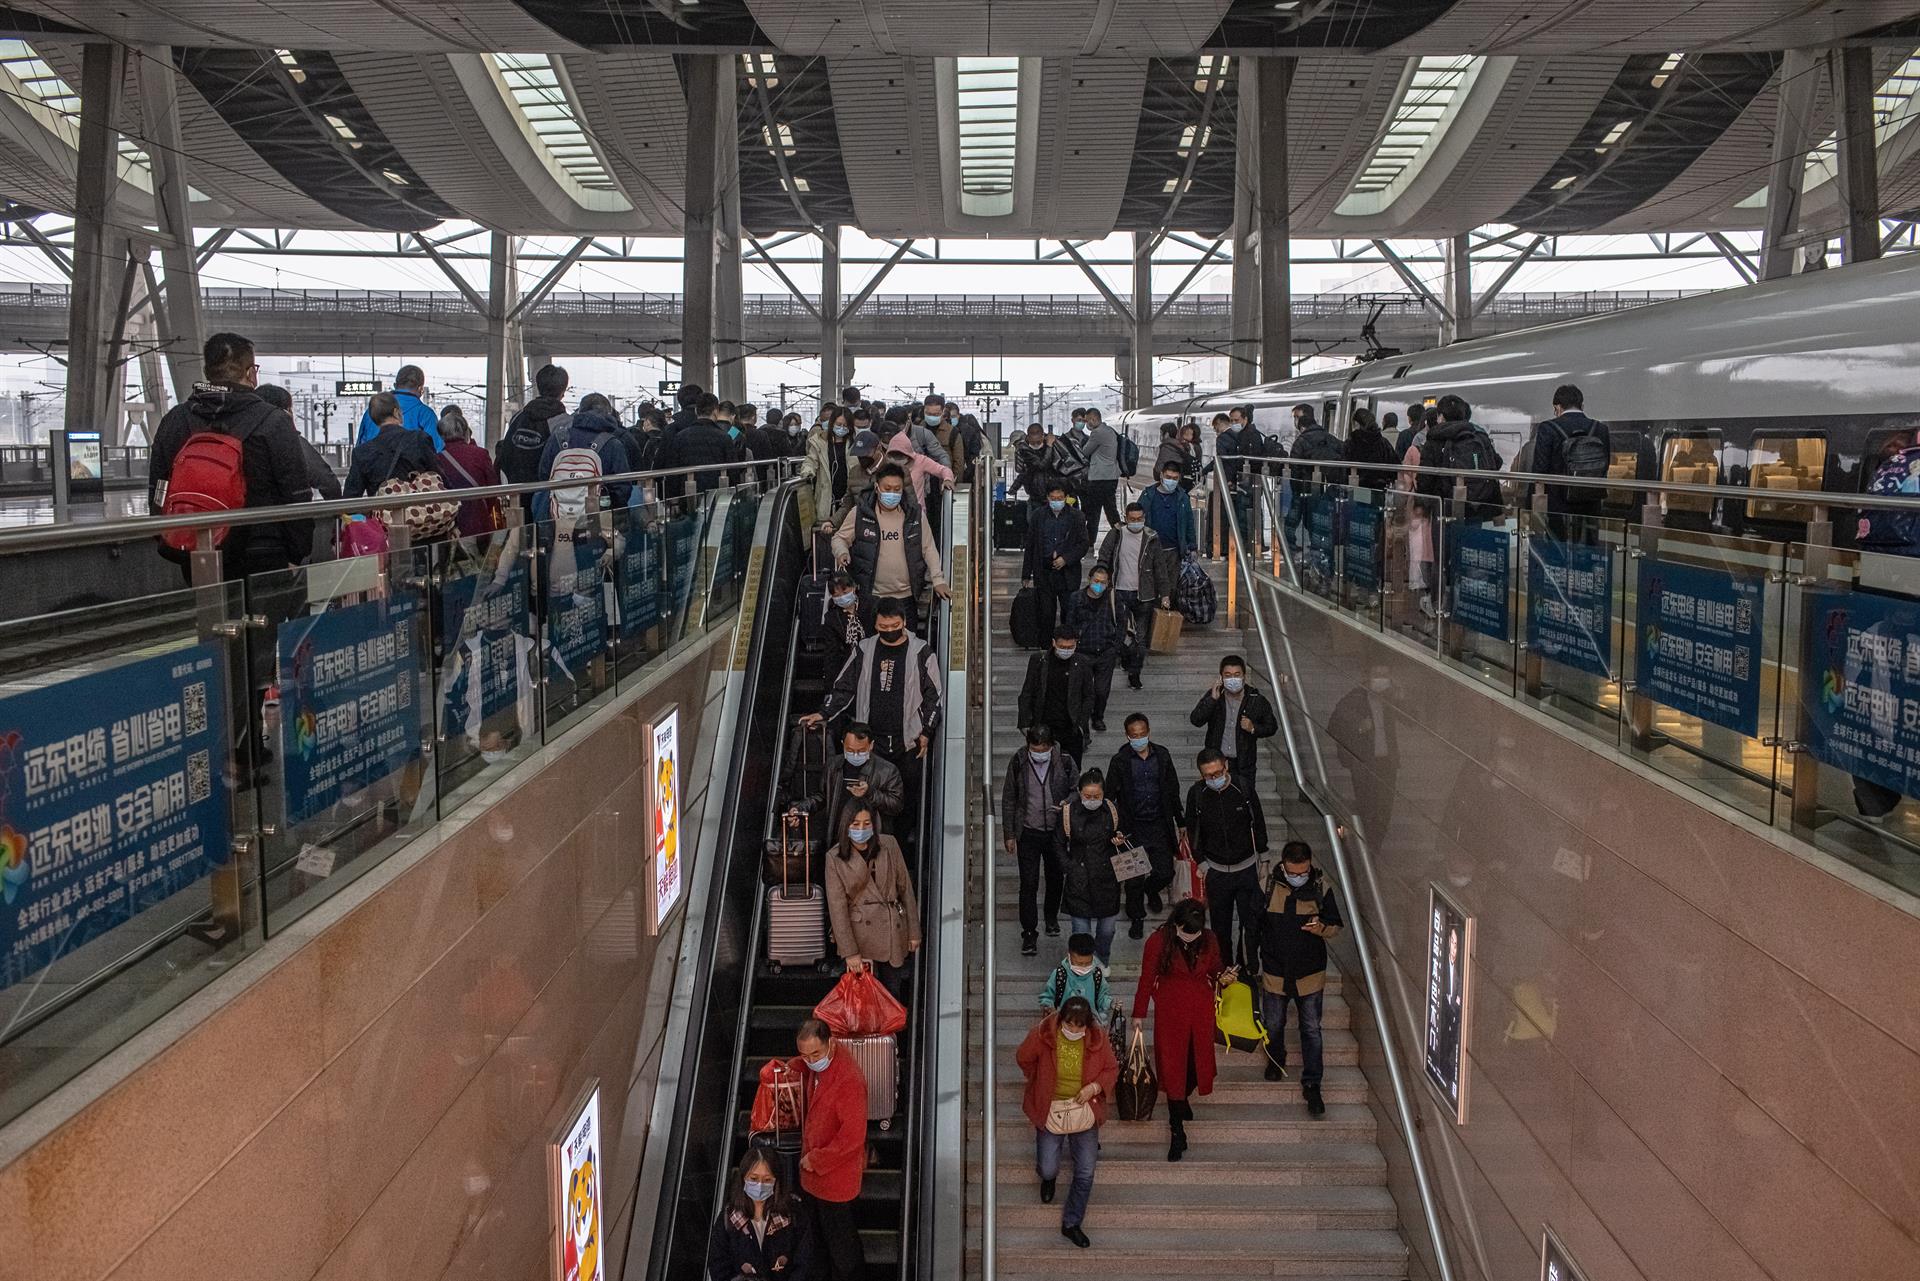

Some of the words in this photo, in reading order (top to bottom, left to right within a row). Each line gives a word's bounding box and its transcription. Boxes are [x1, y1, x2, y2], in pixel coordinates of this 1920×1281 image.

[344, 382, 373, 391] 北京南站
[973, 382, 1001, 390] 北京南站
[881, 530, 899, 541] Lee
[1662, 591, 1695, 620] 远东电缆
[1697, 599, 1734, 630] 省心省电
[358, 633, 394, 671] 省心省电
[1660, 632, 1693, 663] 远东电池
[1696, 642, 1732, 675] 安全耐用
[359, 684, 396, 726] 安全耐用
[24, 727, 106, 796] 远东电缆
[111, 703, 181, 763] 省心省电
[26, 796, 44, 810] FAR
[50, 785, 74, 801] EAST
[80, 773, 107, 789] CABLE
[29, 804, 111, 877] 远东电池
[116, 771, 185, 837] 安全耐用
[32, 877, 48, 890] FAR
[52, 864, 73, 881] EAST
[78, 847, 112, 869] BATTERY
[118, 833, 138, 849] SAFE
[152, 812, 186, 833] DURABLE
[18, 882, 81, 930] 全球行业龙头
[85, 851, 145, 894] 远东产品/服务
